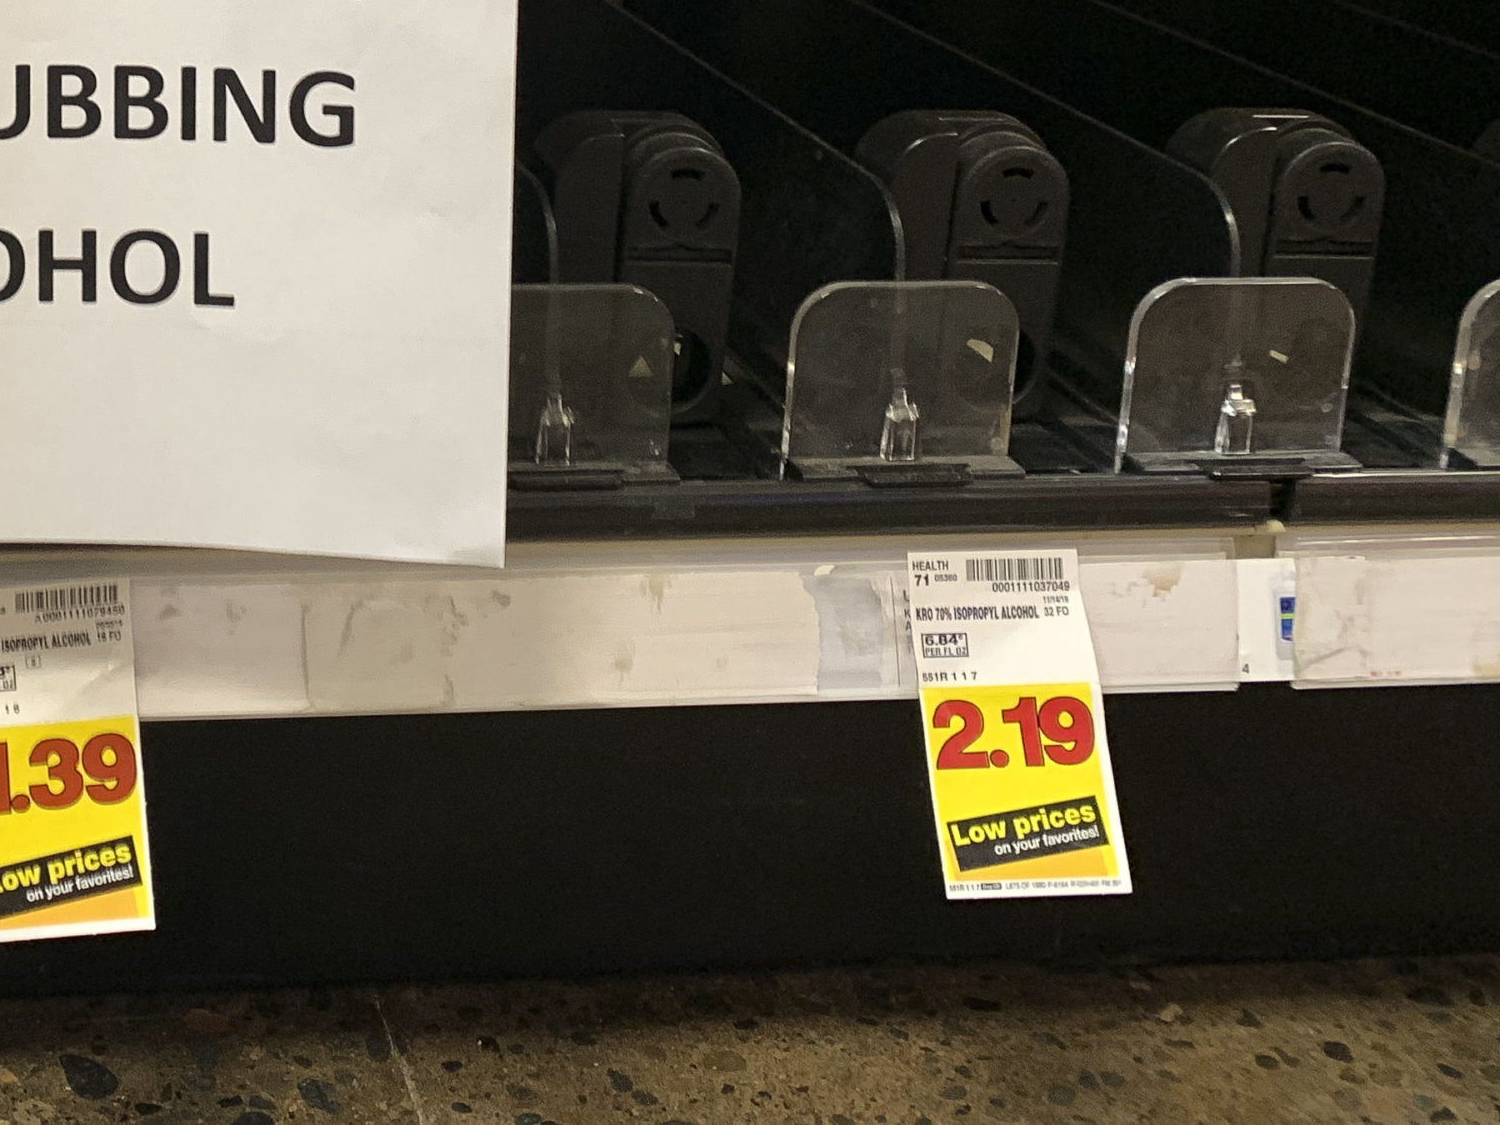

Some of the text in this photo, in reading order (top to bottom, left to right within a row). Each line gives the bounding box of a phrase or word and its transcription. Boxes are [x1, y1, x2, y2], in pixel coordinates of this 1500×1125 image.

[912, 561, 948, 571] HEALTH
[915, 575, 929, 586] 71
[992, 582, 1070, 592] 0001111037049
[916, 608, 933, 621] KRO
[936, 608, 952, 620] 70%
[954, 607, 999, 620] ISOPROPYL
[1001, 606, 1039, 619] ALCOHOL
[1045, 607, 1054, 616] 32
[1057, 607, 1069, 616] FO
[2, 637, 49, 653] ISOPROPYL
[52, 632, 91, 648] ALCOHOL
[925, 647, 967, 656] PER FL OZ
[923, 673, 948, 681] 551R
[933, 696, 1095, 770] 2.19
[950, 805, 1096, 846] Low prices
[995, 825, 1100, 856] on your favorites!
[47, 844, 132, 884] prices
[27, 866, 134, 903] on your favorites!
